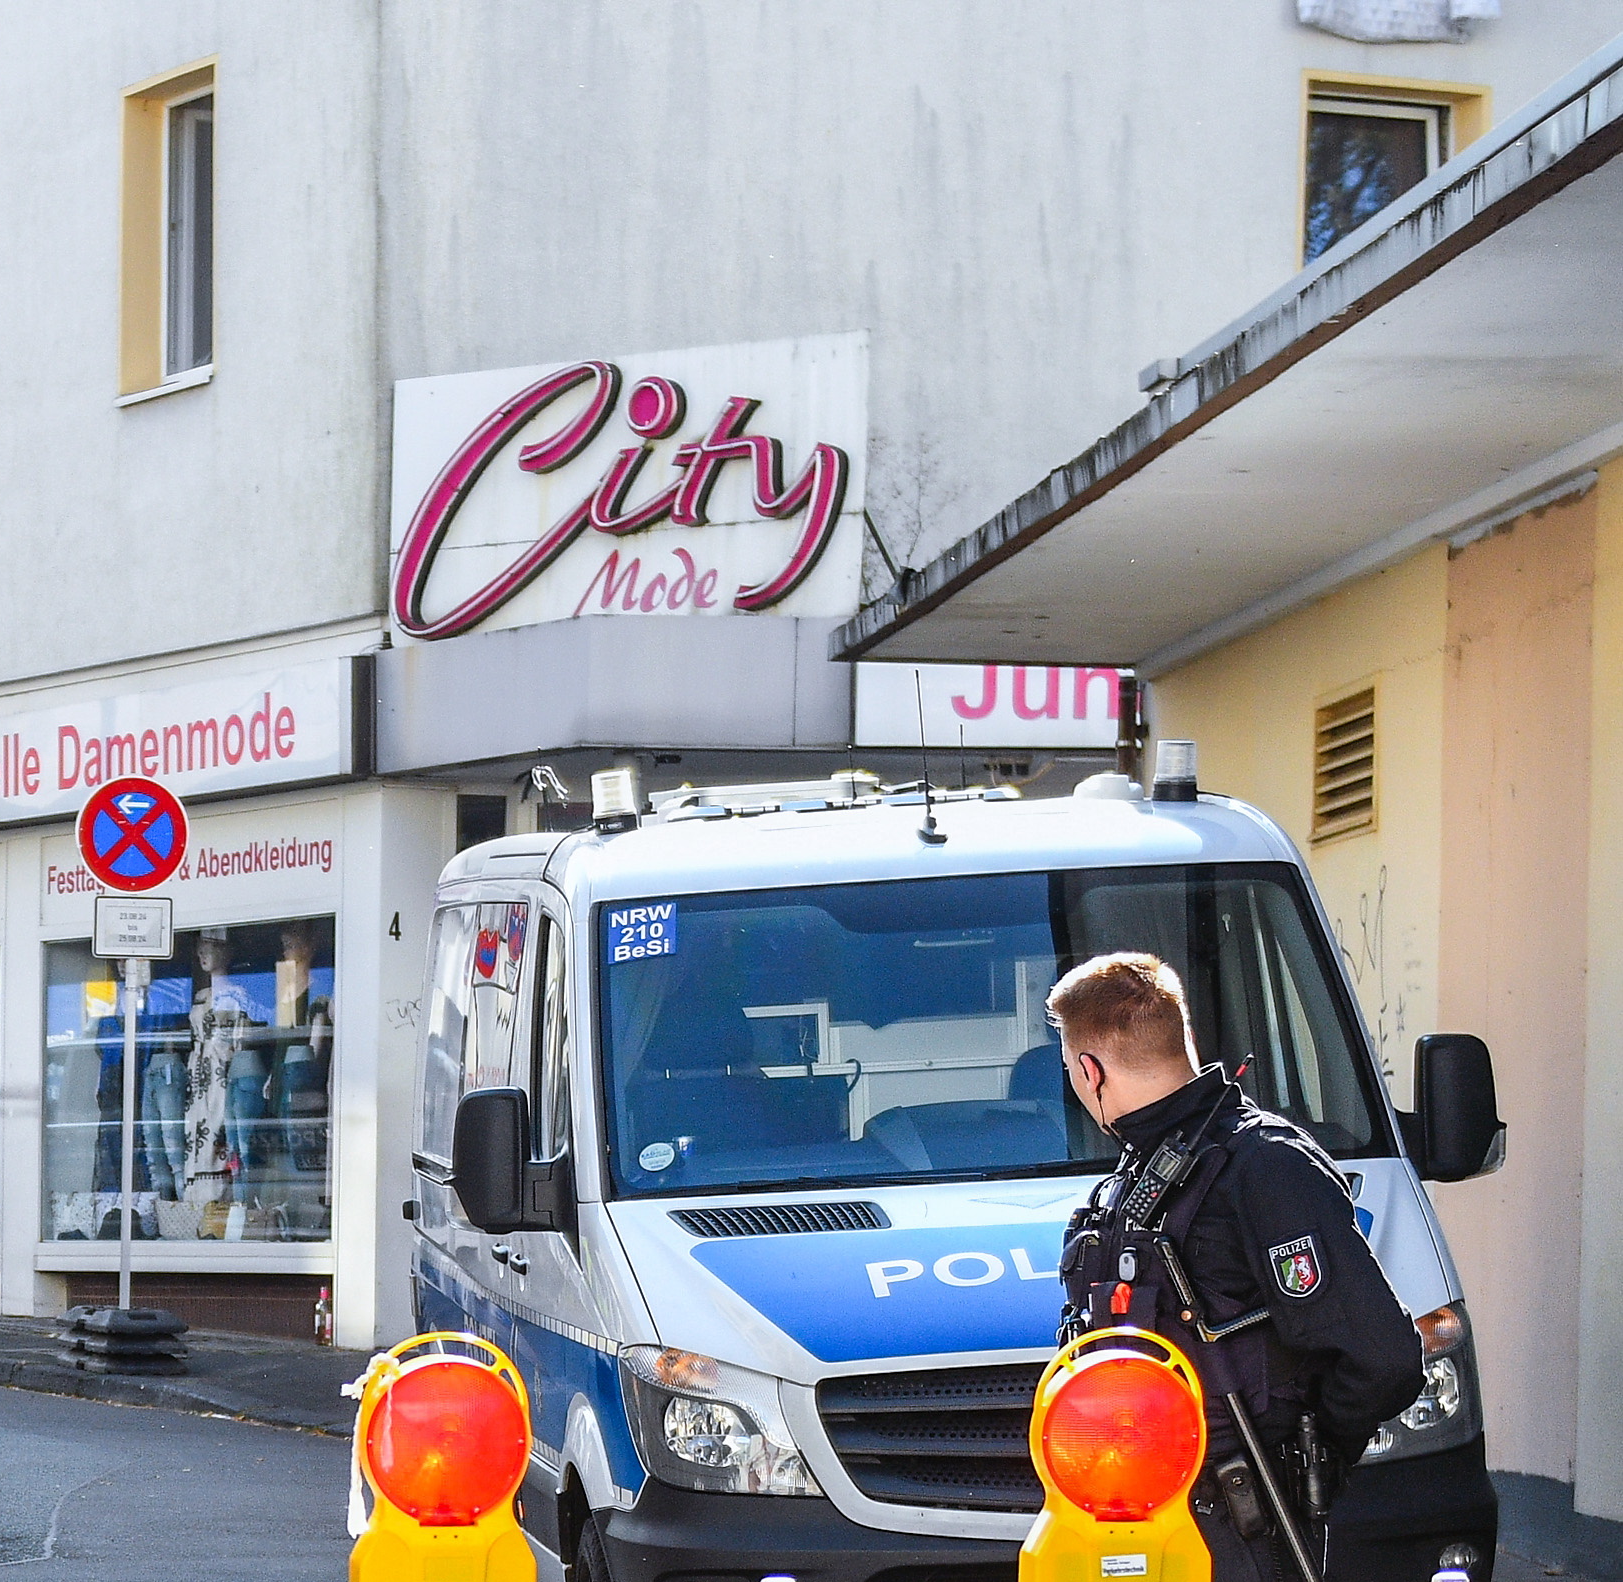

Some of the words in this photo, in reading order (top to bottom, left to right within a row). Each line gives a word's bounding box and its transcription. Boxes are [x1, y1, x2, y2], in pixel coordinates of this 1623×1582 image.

[390, 358, 849, 641] City
[572, 547, 718, 618] Mode
[952, 662, 1120, 721] Jun
[58, 692, 296, 791] Damenmode
[47, 865, 106, 896] Festtag
[178, 859, 192, 880] &
[196, 837, 333, 880] Abendkleidung
[388, 911, 402, 941] 4
[610, 903, 674, 929] NRW
[619, 922, 665, 944] 210
[612, 937, 671, 963] BeSi
[865, 1247, 1060, 1299] POL
[1271, 1238, 1311, 1260] POLIZEI
